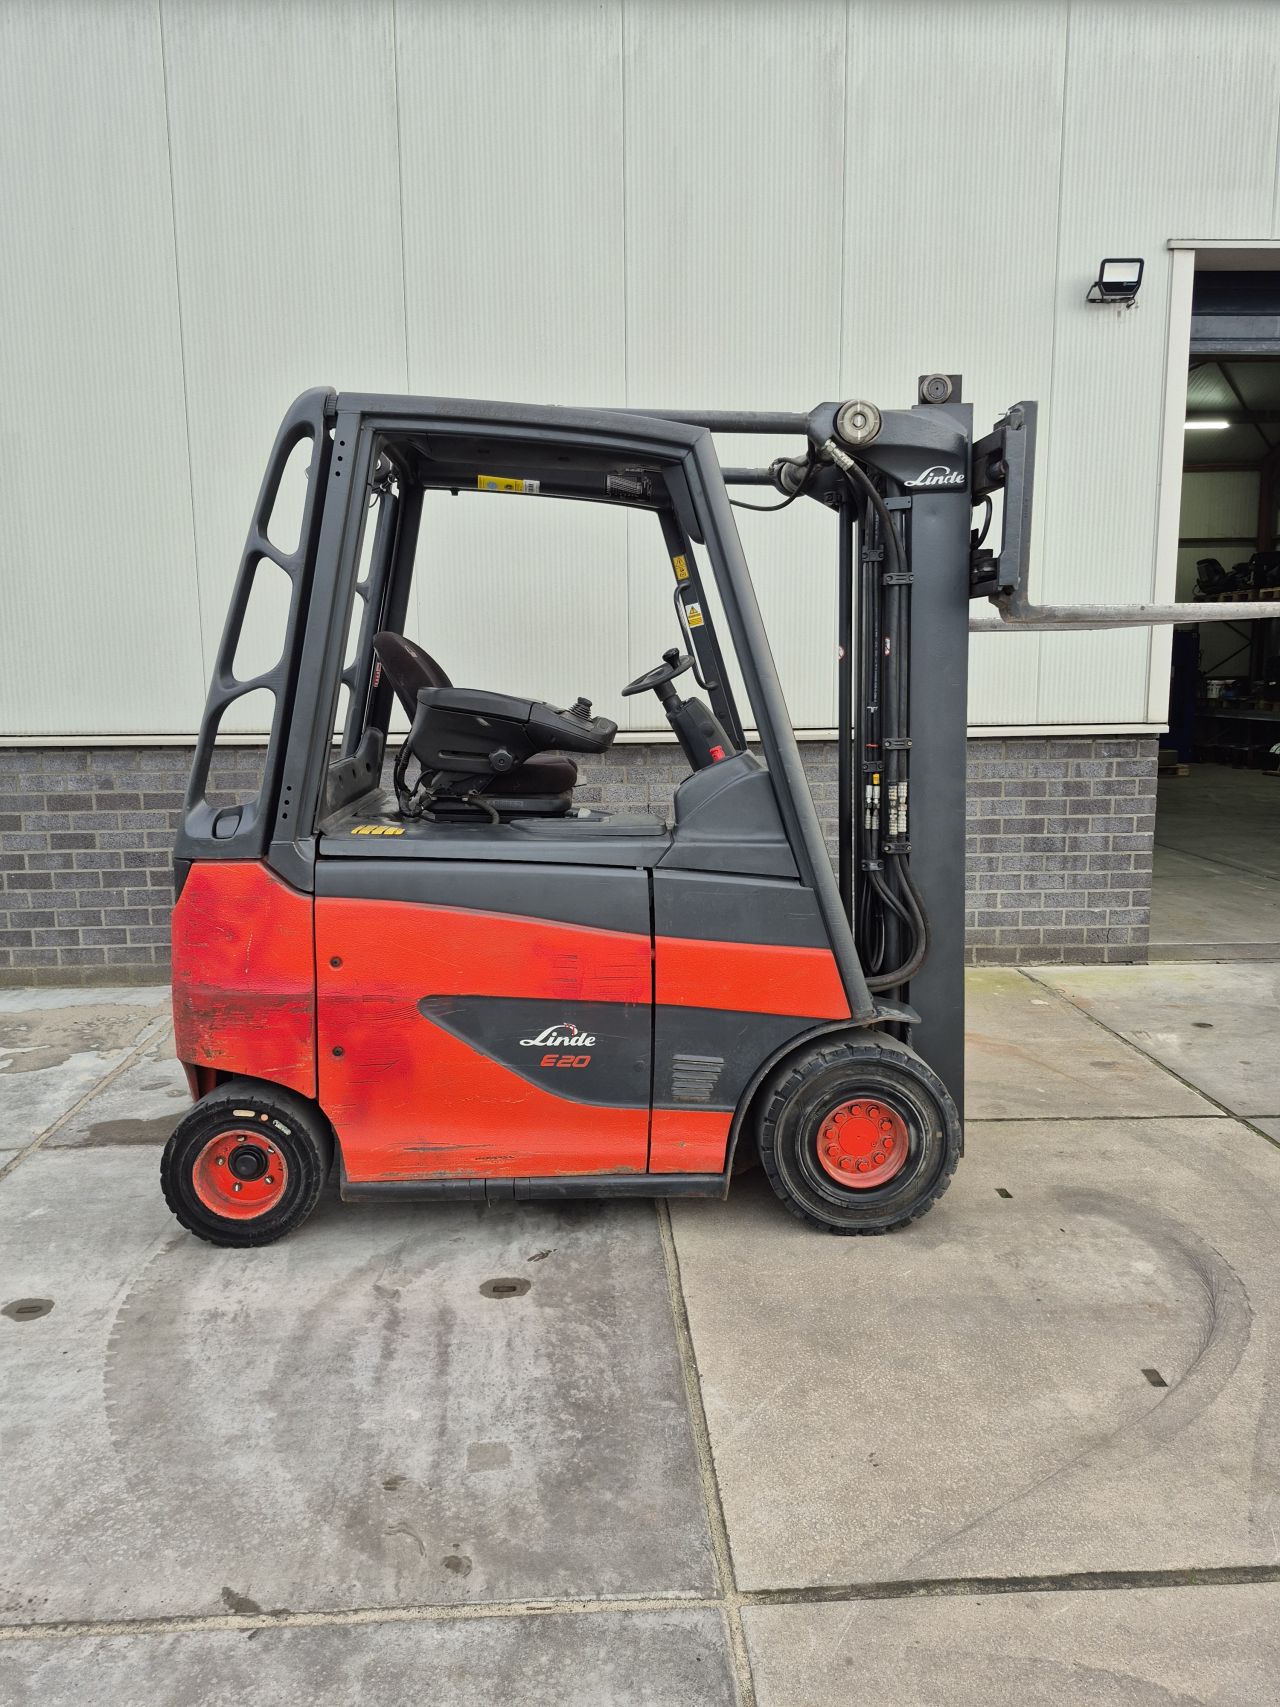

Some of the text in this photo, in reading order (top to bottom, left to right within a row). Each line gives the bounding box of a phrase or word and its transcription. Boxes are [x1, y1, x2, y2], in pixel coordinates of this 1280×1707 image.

[904, 466, 965, 487] Linde
[519, 1022, 596, 1047] Linde
[540, 1054, 592, 1069] E20
